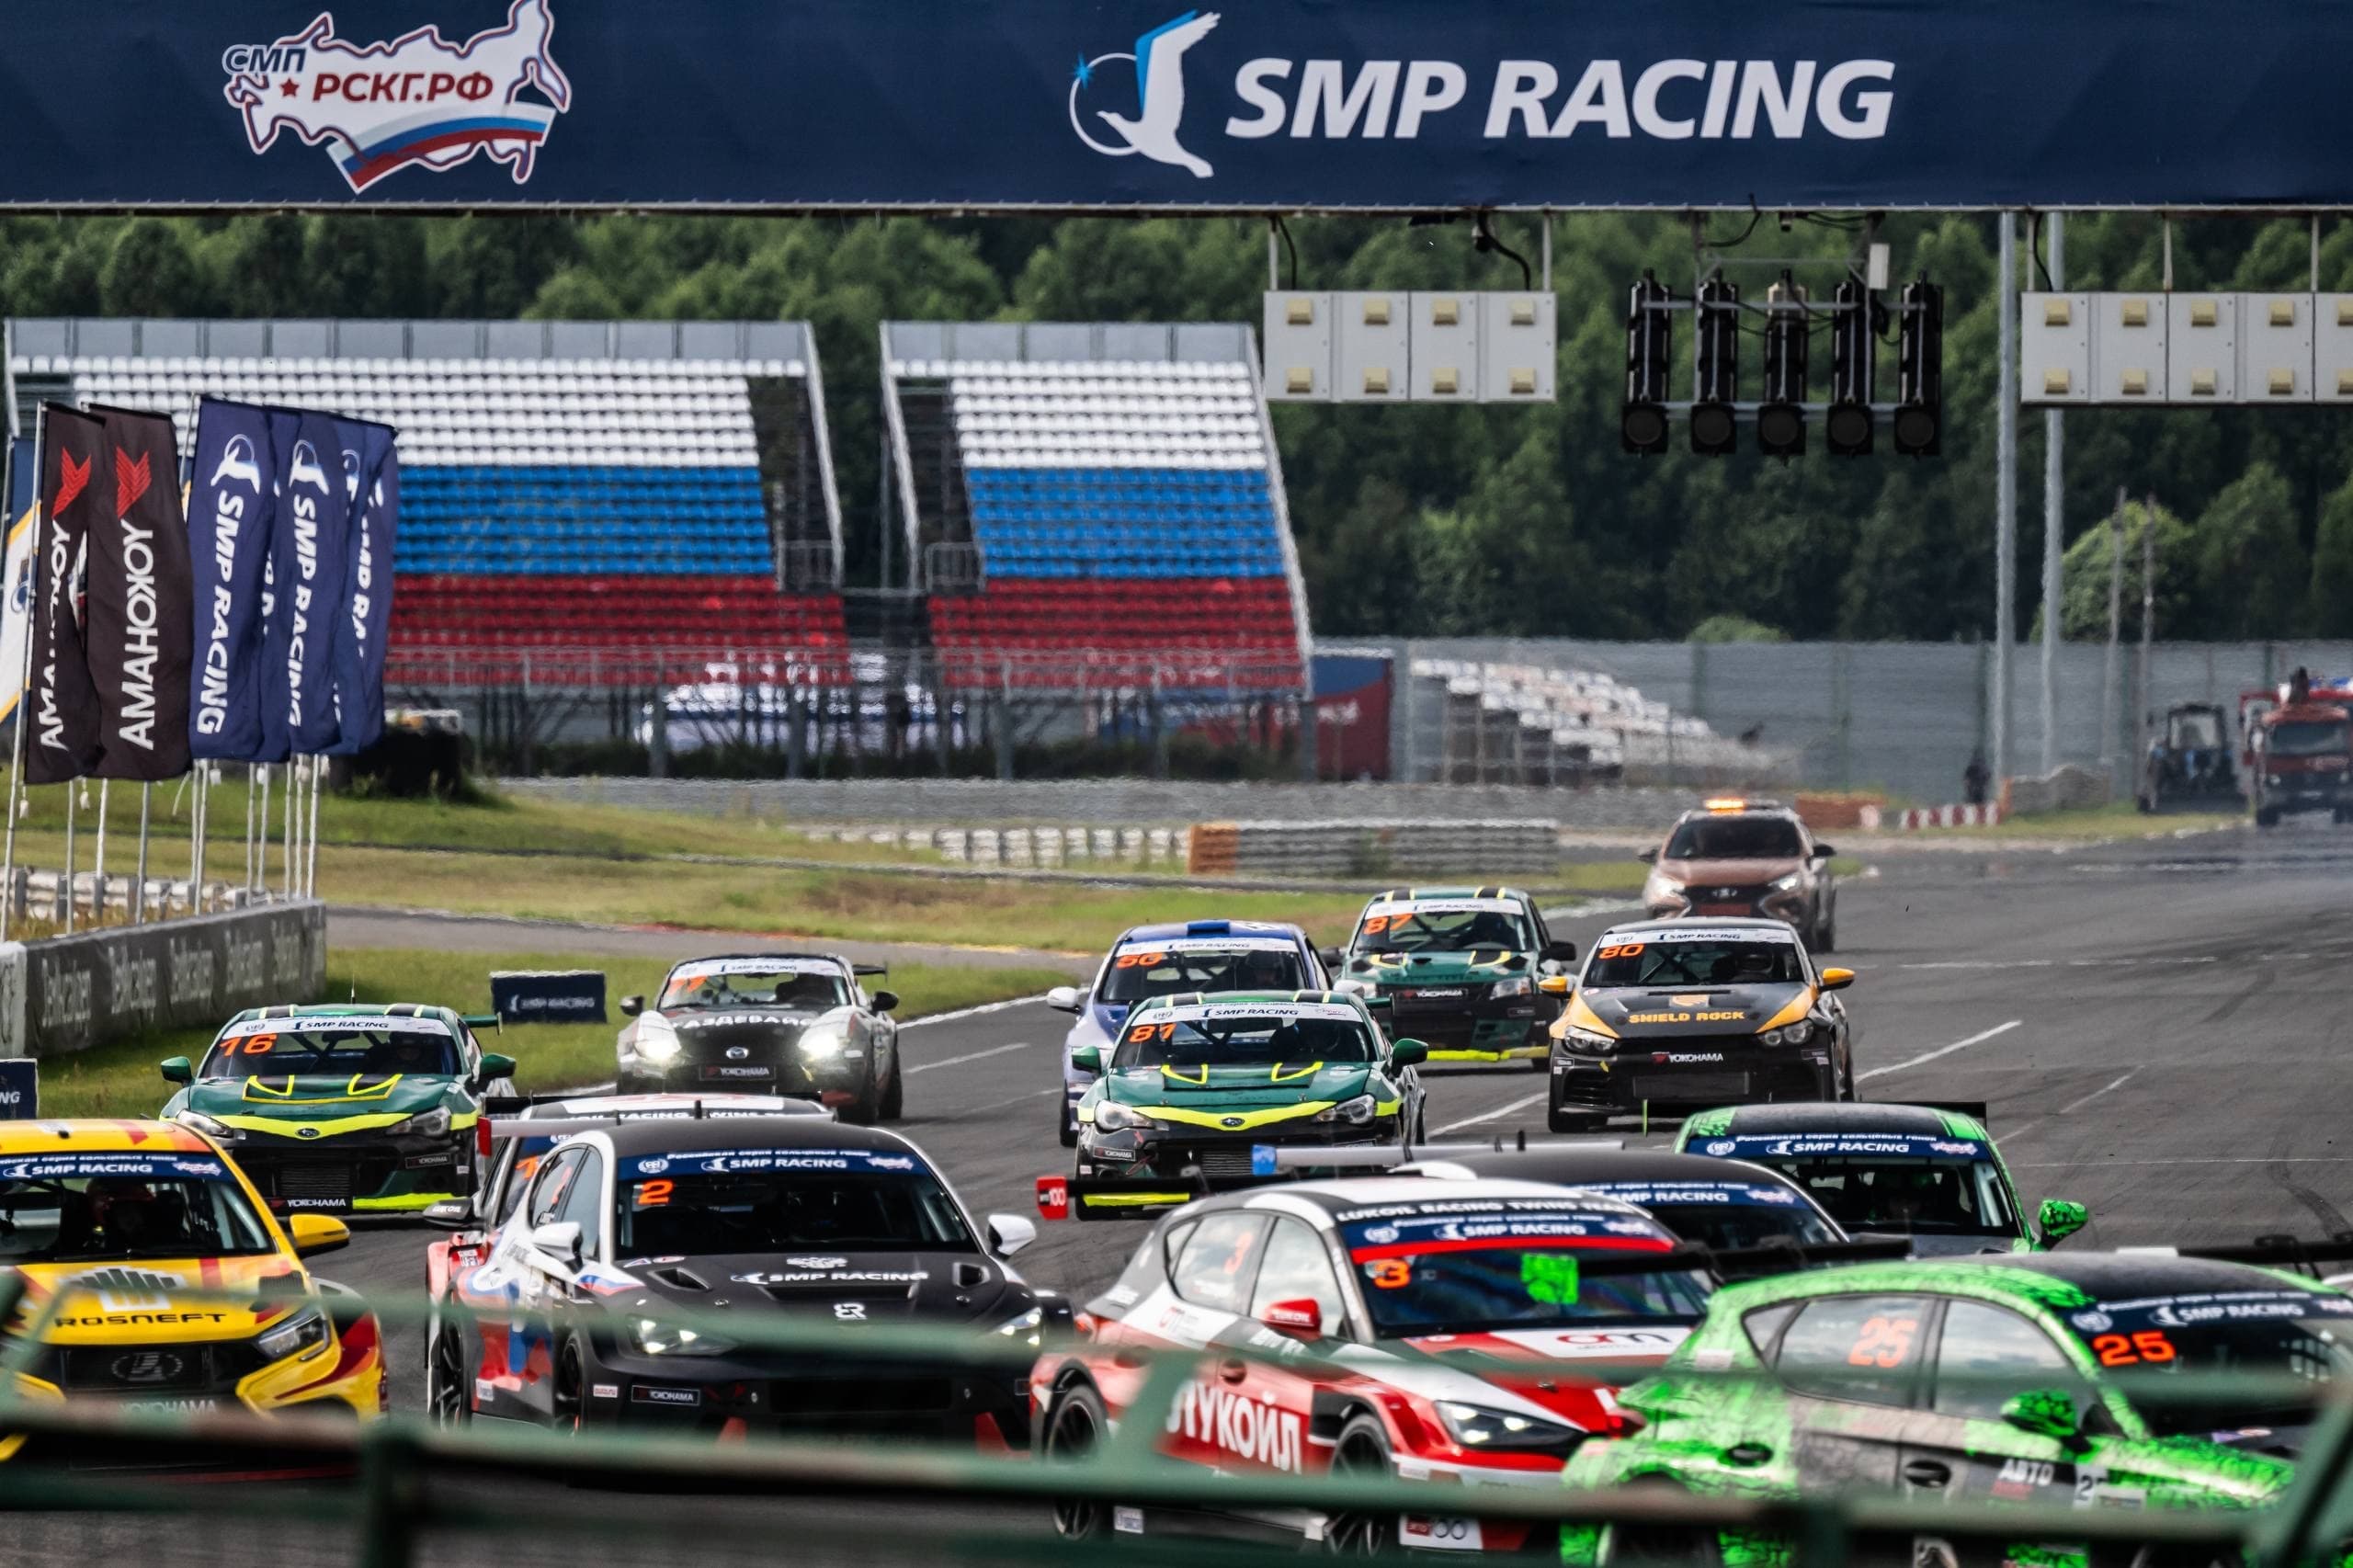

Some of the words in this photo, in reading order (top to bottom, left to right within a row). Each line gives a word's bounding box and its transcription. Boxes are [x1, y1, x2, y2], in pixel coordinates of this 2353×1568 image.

[223, 45, 306, 75] СМП
[313, 73, 494, 102] РСКГ.РФ
[1226, 59, 1467, 139] SMP
[1483, 59, 1896, 140] RACING
[214, 490, 244, 581] SMP
[293, 494, 317, 581] SMP
[197, 585, 233, 733] RACING
[1363, 914, 1413, 935] 87
[1598, 943, 1645, 960] 80
[1629, 1014, 1690, 1023] SHIELD
[1696, 1011, 1745, 1021] ROCK
[1129, 1023, 1176, 1043] 81
[221, 1032, 278, 1056] 16
[1668, 1052, 1723, 1062] YOKOHAMA
[721, 1066, 769, 1075] YOKOHAMA
[1793, 1142, 1836, 1152] SMP
[1838, 1142, 1909, 1152] RACING
[32, 1165, 74, 1175] SMP
[79, 1164, 153, 1174] RACING
[730, 1159, 772, 1168] SMP
[775, 1158, 847, 1168] RACING
[638, 1180, 674, 1205] 2
[1655, 1192, 1729, 1202] RACING
[287, 1199, 347, 1208] YOKOHAMA
[1419, 1201, 1504, 1212] RACING
[1463, 1225, 1508, 1236] SMP
[1511, 1224, 1586, 1235] RACING
[768, 1273, 826, 1281] SMP
[831, 1272, 929, 1280] RACING
[1374, 1258, 1410, 1289] 3
[55, 1313, 227, 1326] ROSNEFT
[2178, 1307, 2224, 1321] SMP
[2226, 1303, 2305, 1316] RACING
[1847, 1316, 1918, 1368] 25
[2093, 1331, 2176, 1367] 25
[649, 1391, 694, 1403] YOKOHAMA
[1165, 1381, 1303, 1475] ЛУКОЙЛ
